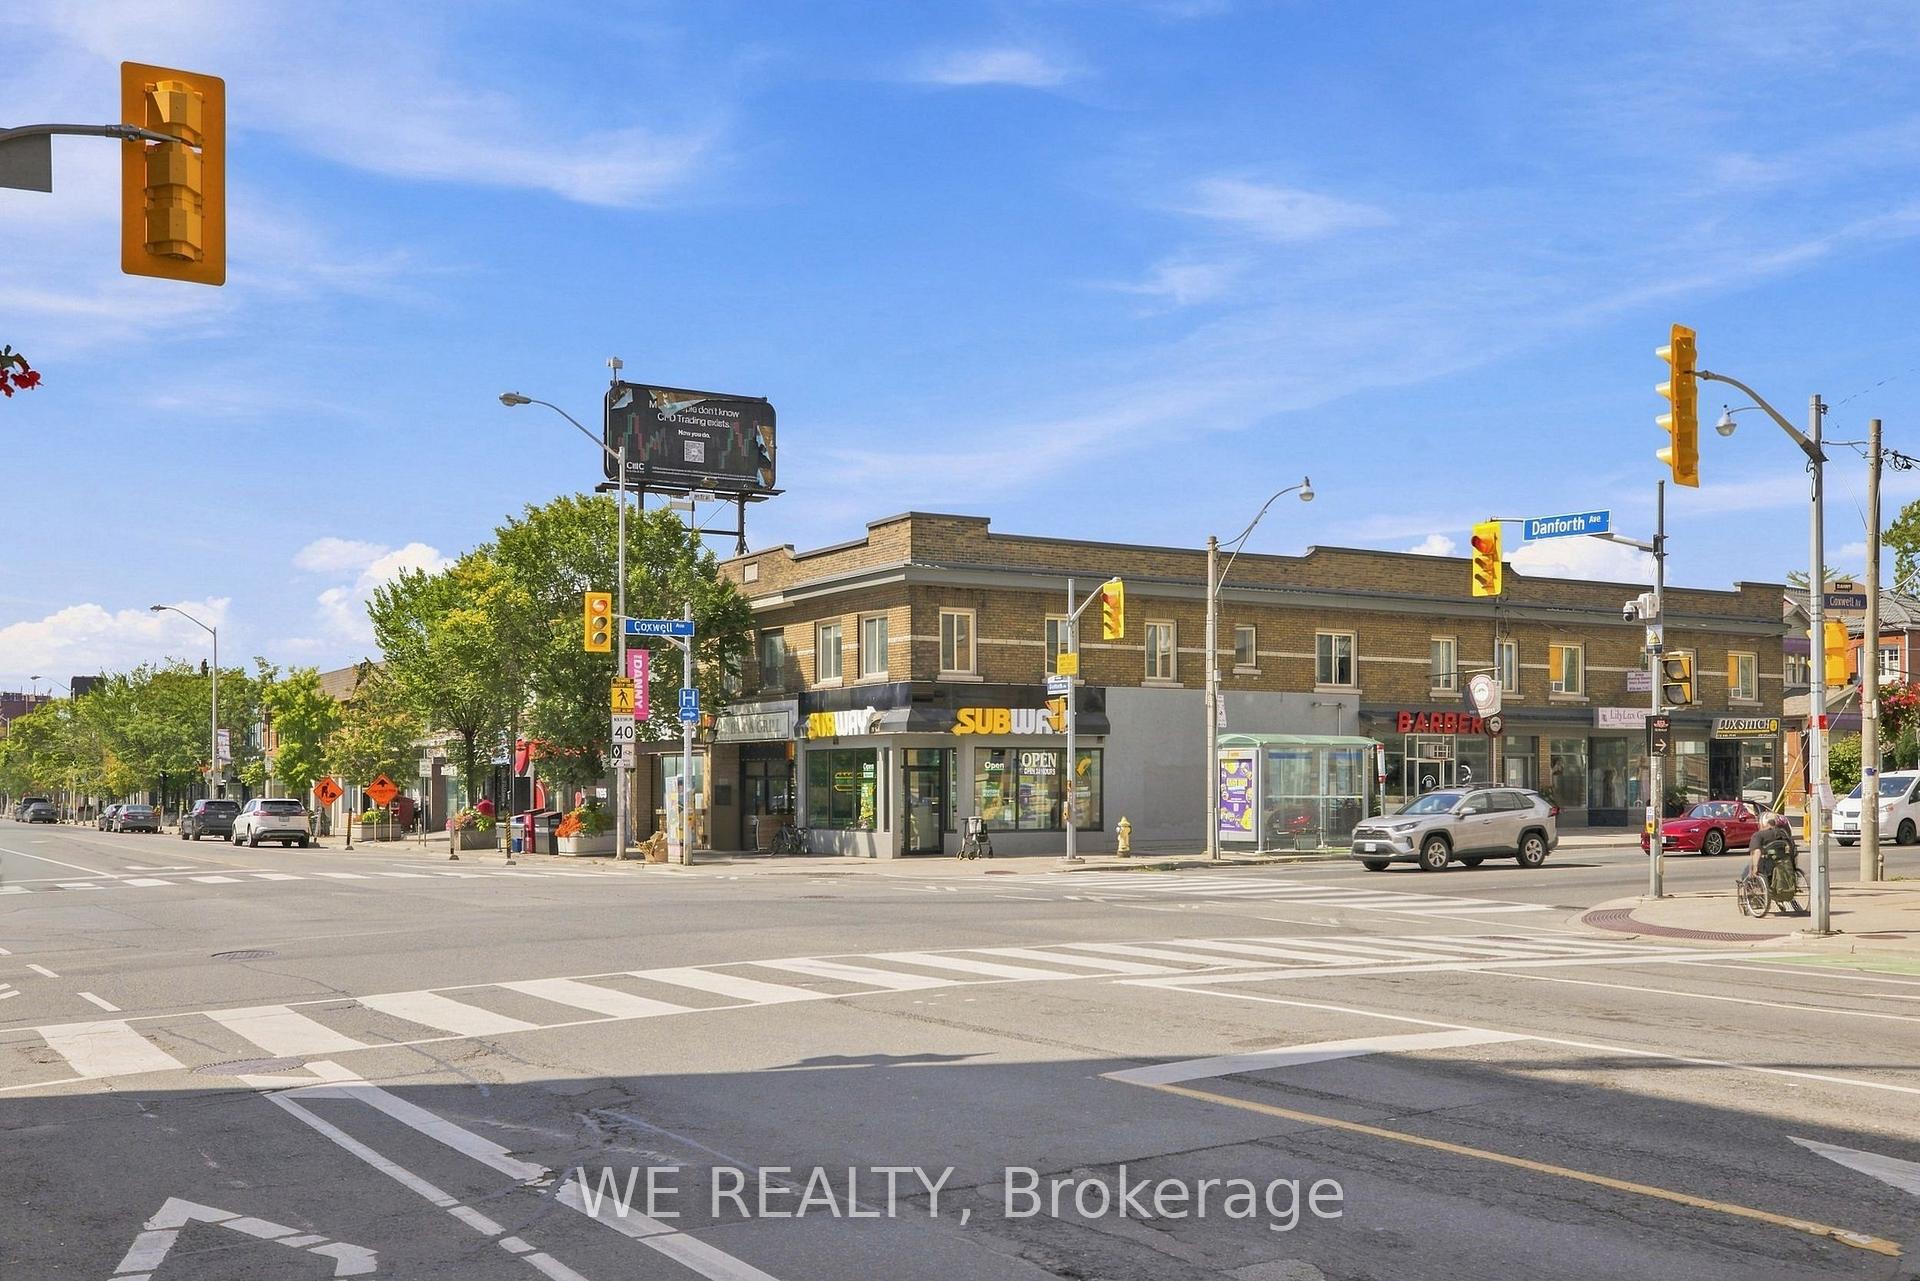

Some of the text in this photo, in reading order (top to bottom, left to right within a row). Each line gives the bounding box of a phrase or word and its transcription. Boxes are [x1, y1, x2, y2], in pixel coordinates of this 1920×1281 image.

[698, 406, 717, 416] don't
[718, 408, 740, 418] know
[677, 415, 706, 427] Trading
[1532, 515, 1601, 535] Danforth Ave
[1830, 596, 1854, 606] Coxwell
[634, 621, 673, 632] Coxwell
[682, 691, 696, 706] H
[807, 706, 876, 741] SUBWAY
[950, 707, 1076, 736] SUBWA
[1397, 711, 1484, 733] BARBER
[615, 726, 633, 739] 40
[984, 761, 1005, 769] Open
[1022, 752, 1057, 768] OPEN
